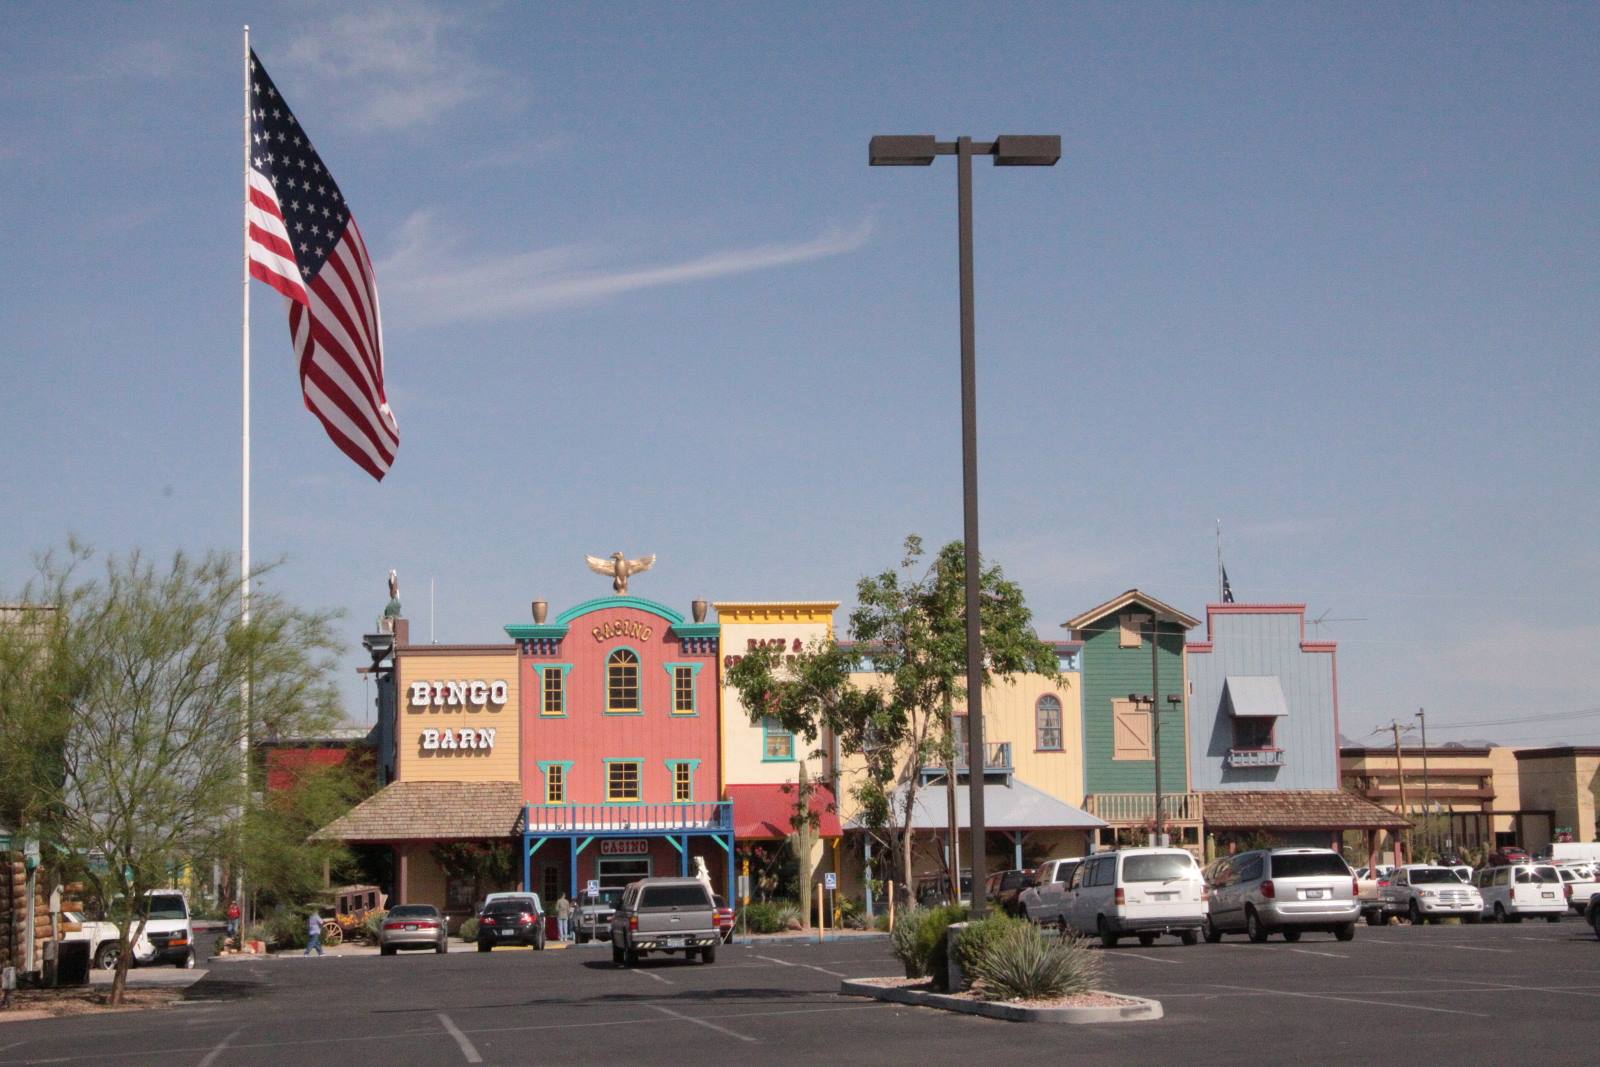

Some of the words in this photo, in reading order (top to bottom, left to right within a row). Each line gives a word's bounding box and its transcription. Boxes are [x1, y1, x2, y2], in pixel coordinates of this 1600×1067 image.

[592, 619, 653, 643] CASINO
[792, 638, 803, 653] &
[410, 680, 508, 706] BINGO
[421, 727, 497, 750] BARN
[602, 840, 647, 853] CASINO
